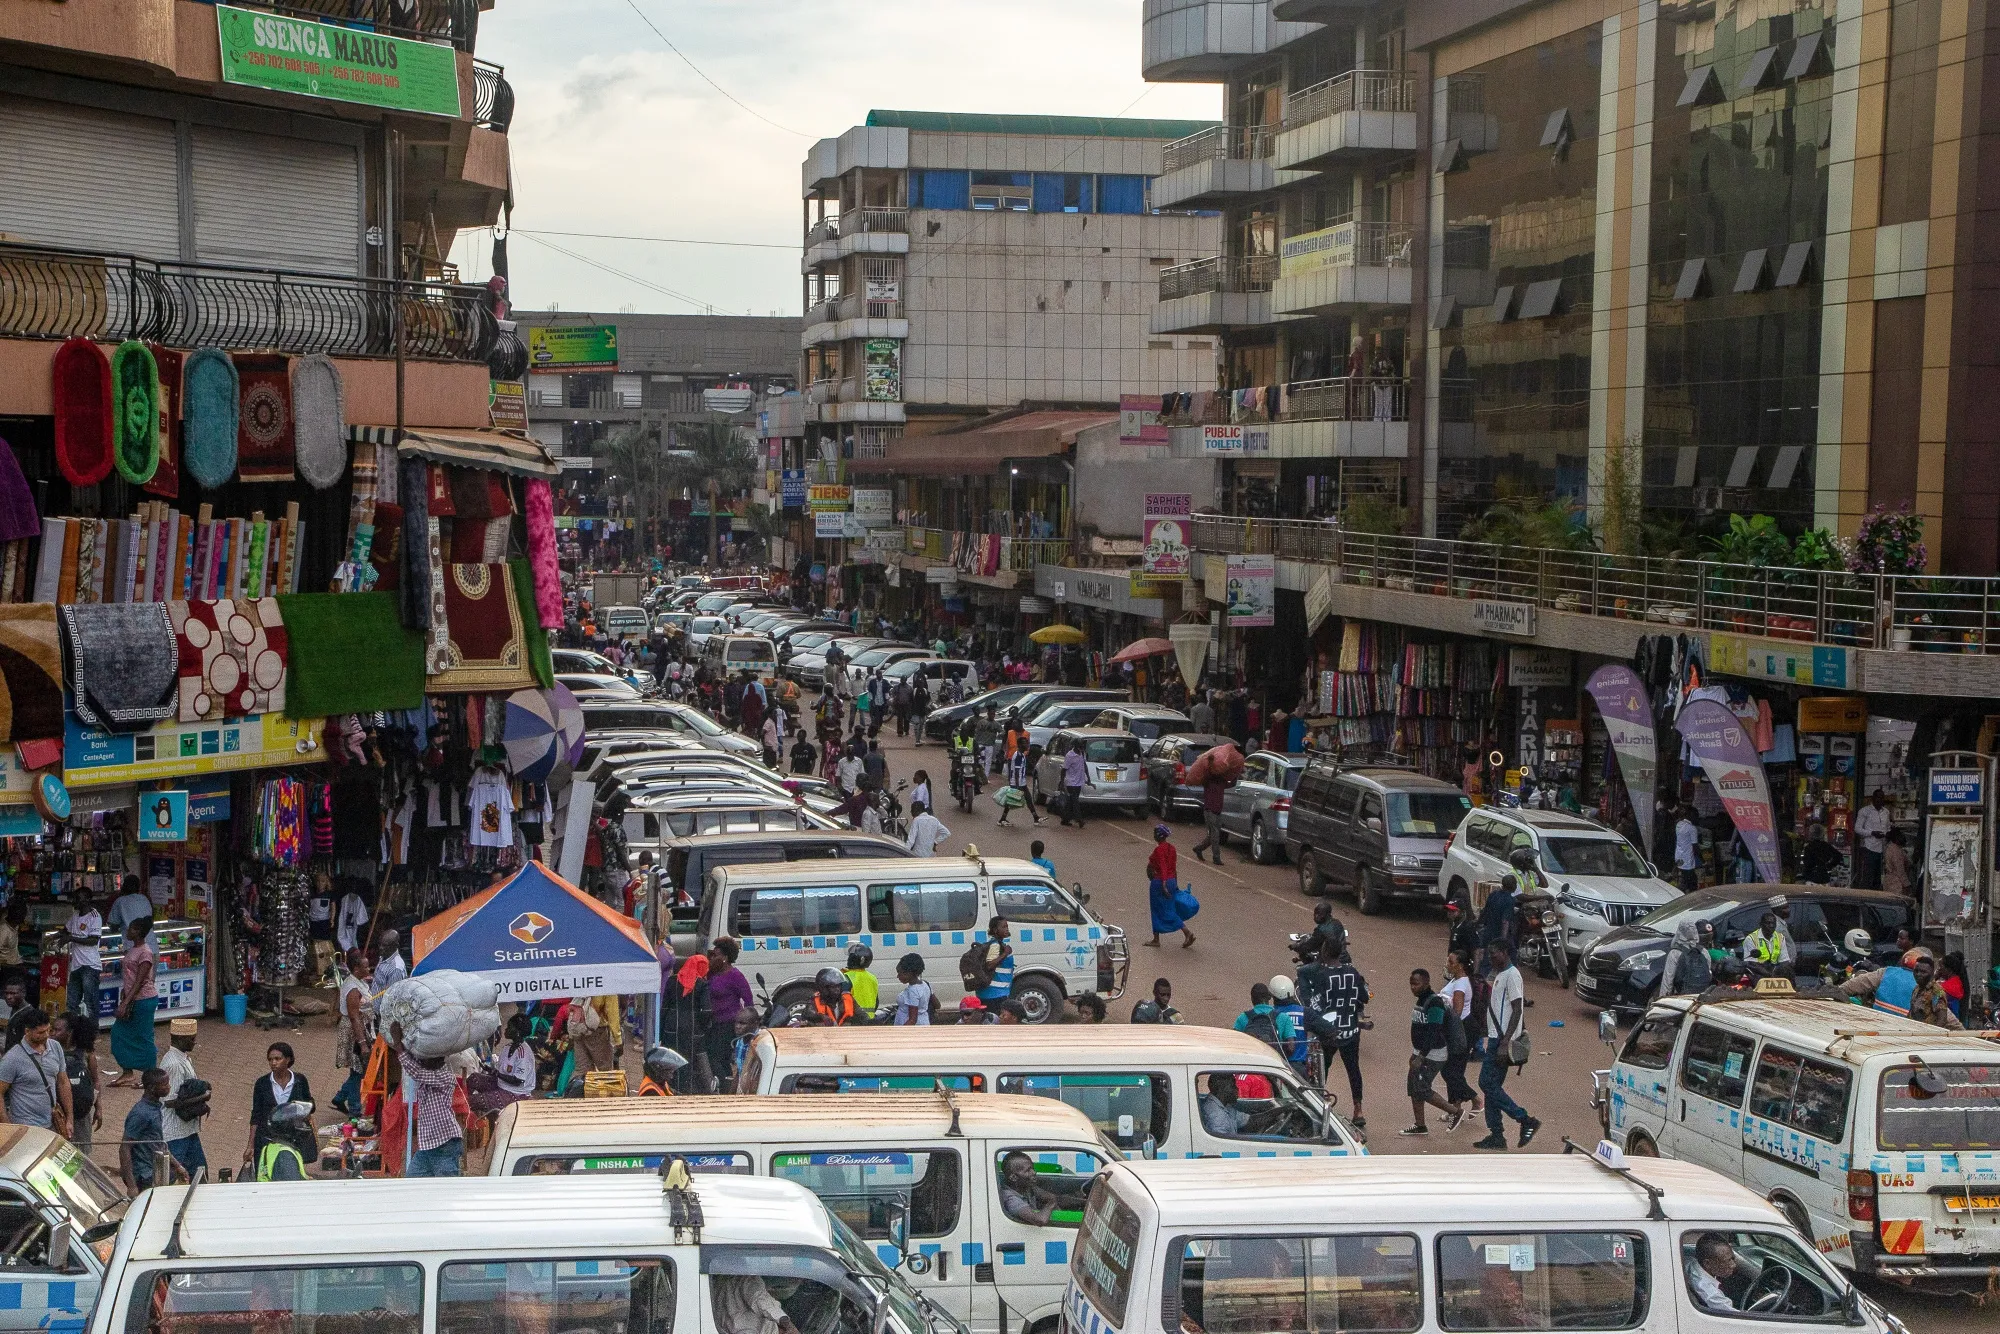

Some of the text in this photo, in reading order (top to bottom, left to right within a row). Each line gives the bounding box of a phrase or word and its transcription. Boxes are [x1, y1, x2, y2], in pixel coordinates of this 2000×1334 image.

[253, 16, 398, 69] SSENGA MARUS
[1205, 426, 1240, 438] PUBLIC
[1206, 439, 1242, 449] TOILETS
[812, 487, 850, 499] TIENS
[1146, 495, 1190, 506] SAPHIE'S
[1146, 506, 1190, 515] BRIDALS
[1474, 603, 1526, 624] JM PHARMACY
[1514, 666, 1568, 674] PHARMACY
[91, 741, 108, 749] Bank
[83, 753, 115, 762] CenteAgent
[1962, 775, 1979, 784] MEWS
[188, 805, 216, 820] Agent
[147, 830, 178, 838] wave
[494, 947, 577, 962] StarTimes
[515, 979, 569, 993] DIGITAL
[573, 976, 604, 989] LIFE
[1764, 979, 1788, 989] TAXI
[1599, 1141, 1612, 1160] TAXI
[597, 1160, 629, 1169] INSHA
[696, 1156, 727, 1167] Allah
[787, 1157, 811, 1165] ALHA
[826, 1154, 892, 1165] Bismillah
[1881, 1173, 1915, 1187] UAS
